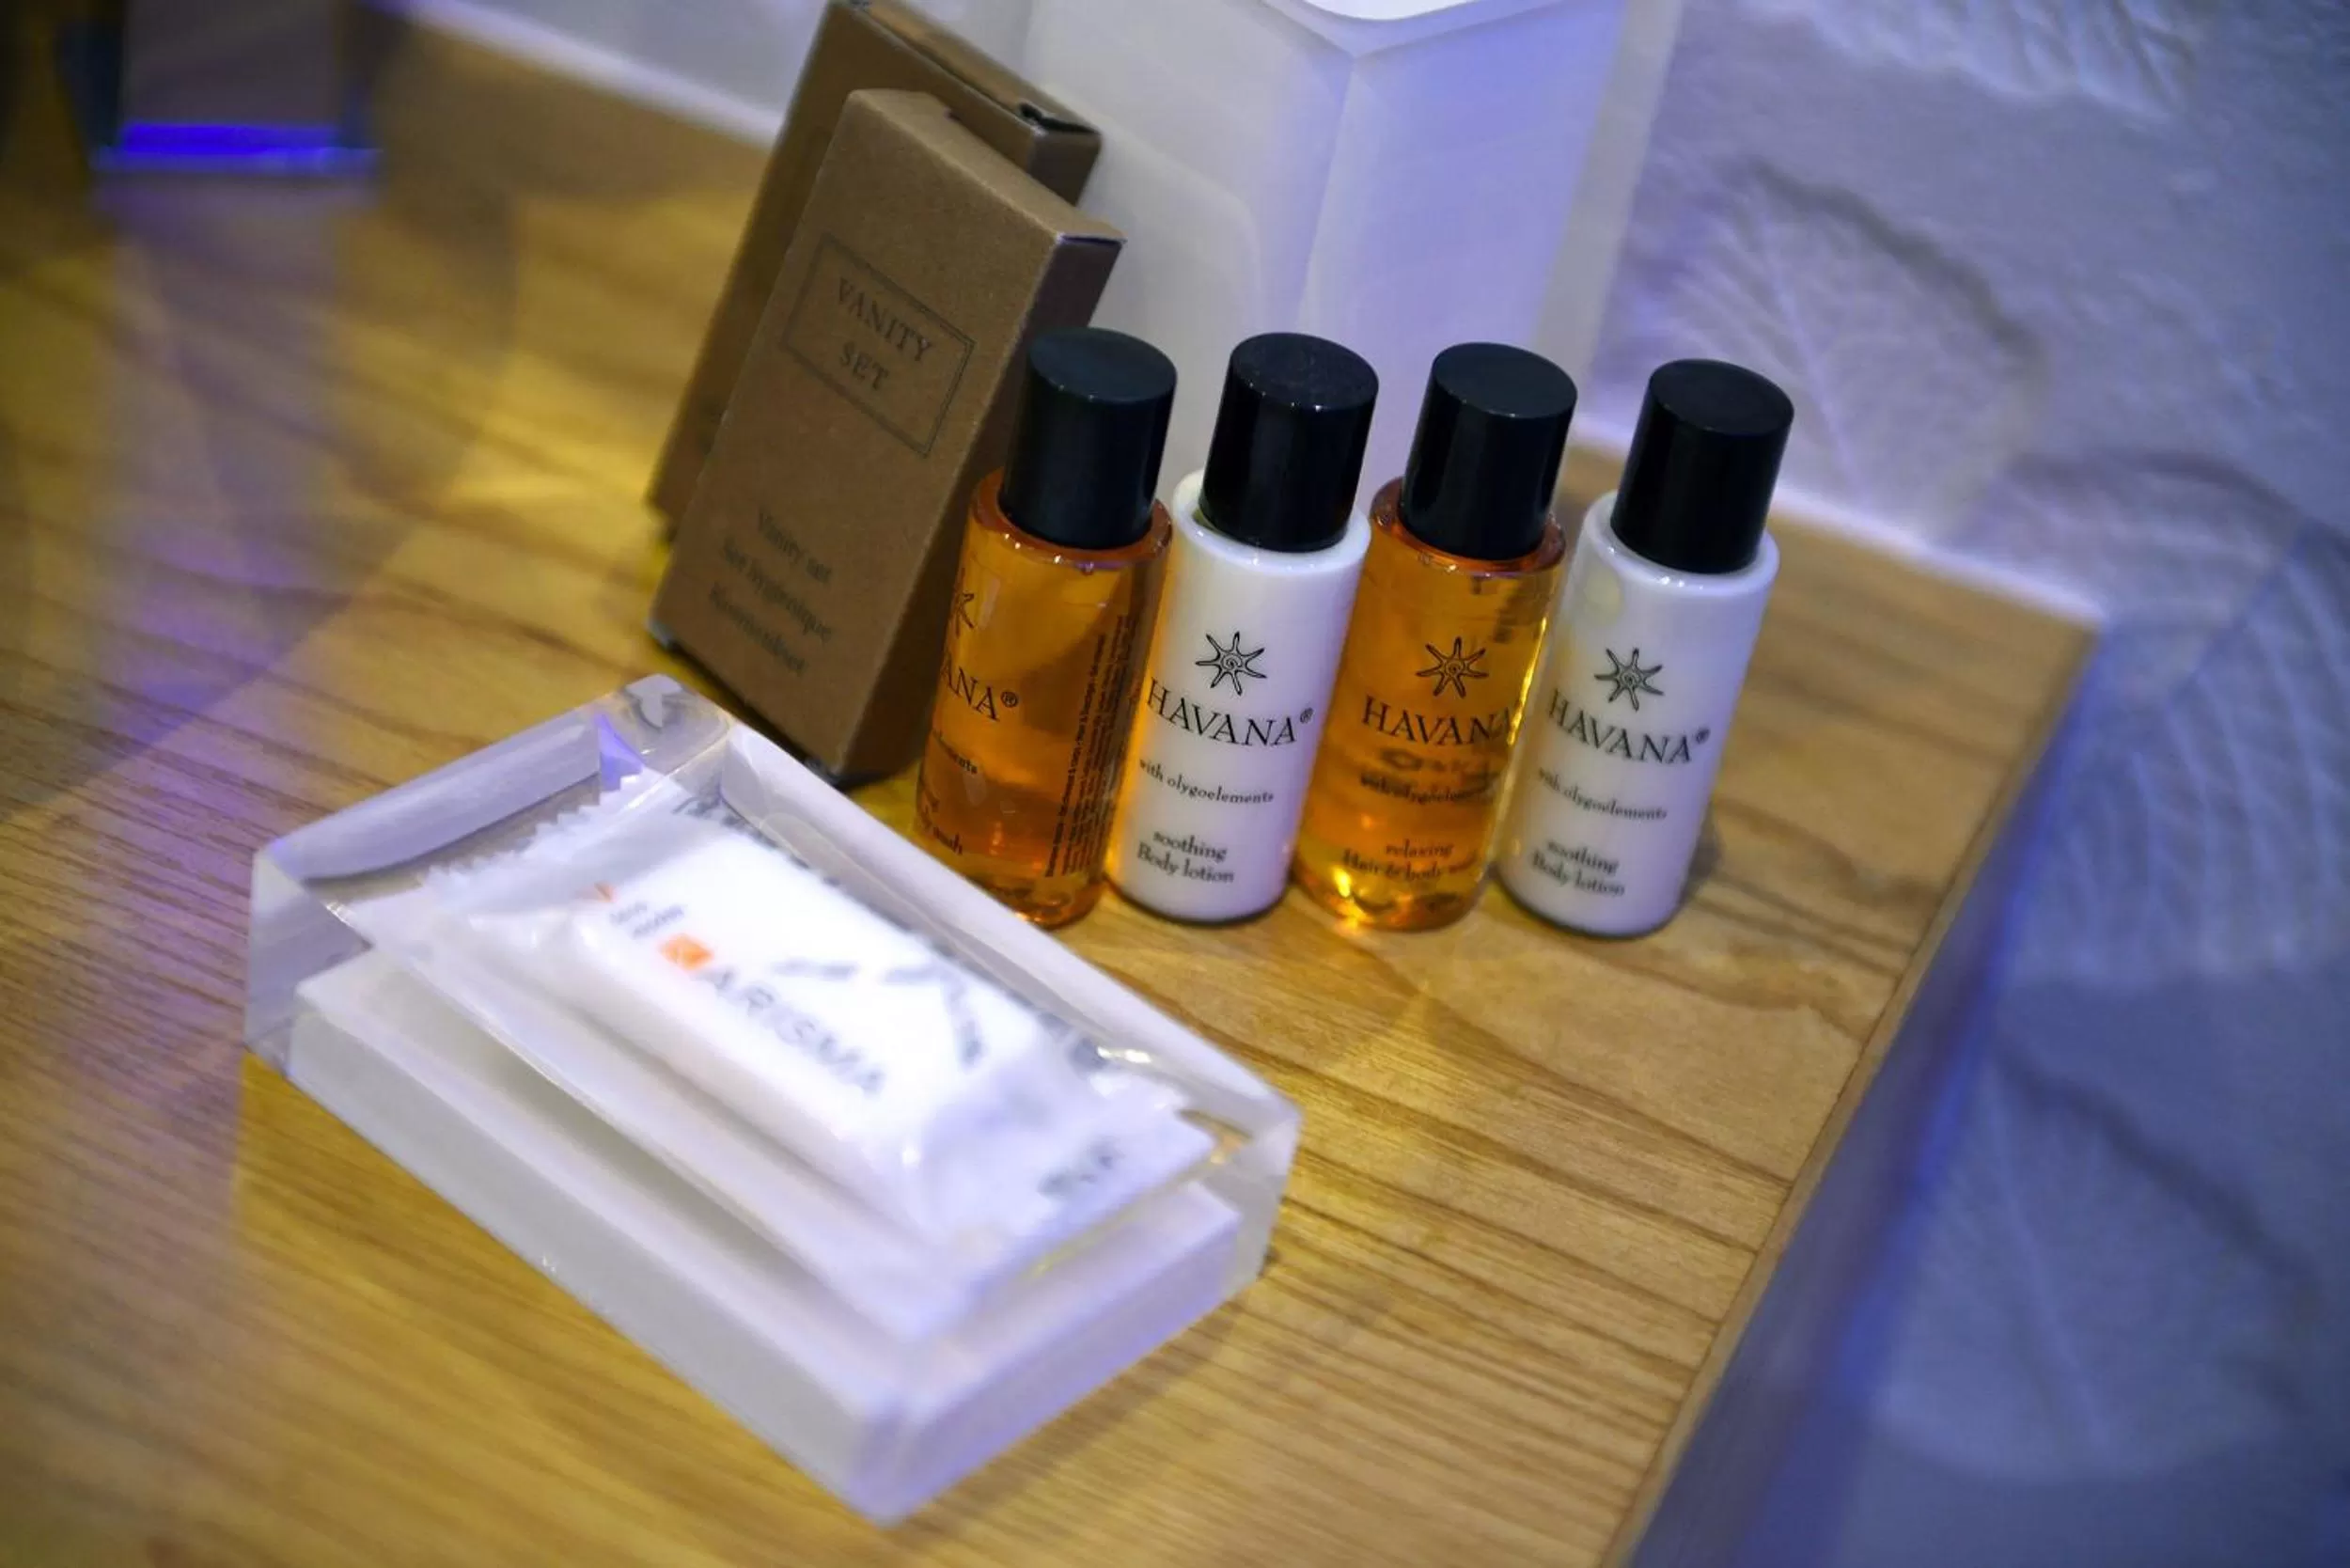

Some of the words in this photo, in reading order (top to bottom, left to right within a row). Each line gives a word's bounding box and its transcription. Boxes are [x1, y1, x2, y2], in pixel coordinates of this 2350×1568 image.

[838, 276, 933, 362] VANITY
[839, 340, 890, 390] SET
[1138, 756, 1165, 784] with
[1167, 770, 1275, 805] olygoelements
[1136, 842, 1180, 875] Body
[1183, 855, 1235, 884] lotion
[1152, 829, 1228, 863] soothing
[1546, 840, 1620, 876] soothing
[1532, 848, 1571, 886] Body
[1574, 868, 1626, 897] lotion
